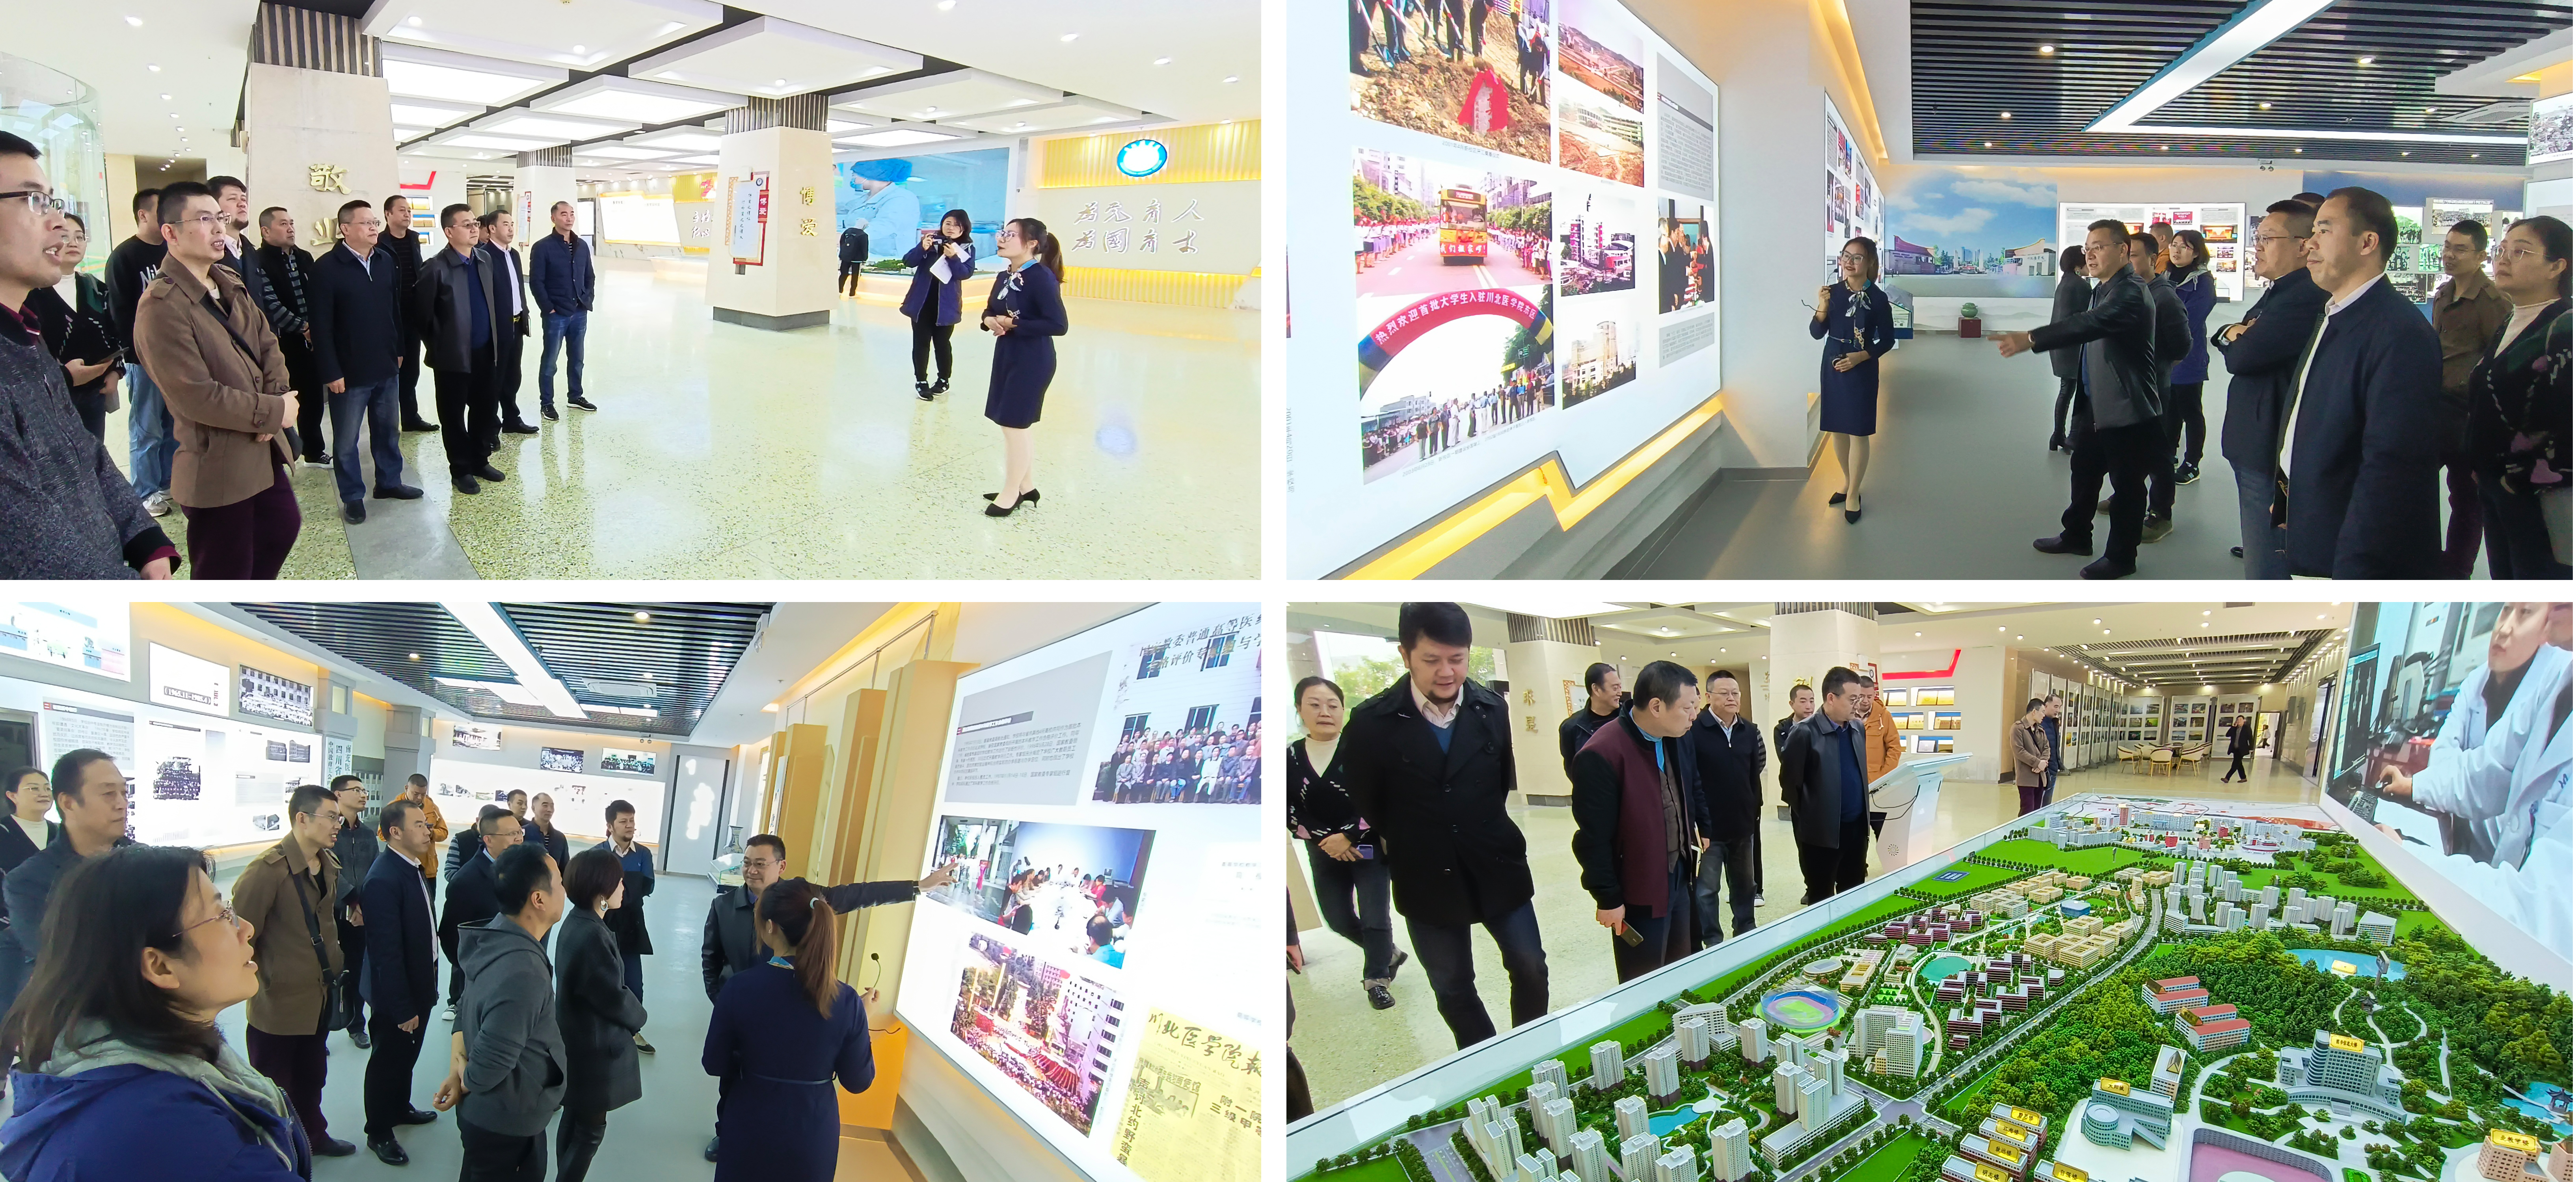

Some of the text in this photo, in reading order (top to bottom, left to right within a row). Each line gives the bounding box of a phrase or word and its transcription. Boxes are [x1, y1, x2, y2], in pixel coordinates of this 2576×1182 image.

[759, 197, 767, 216] 博爱
[800, 186, 819, 236] 博爱
[1375, 292, 1537, 345] 热烈欢迎首批大学生入驻川北医学院东区
[1523, 688, 1539, 733] 求是
